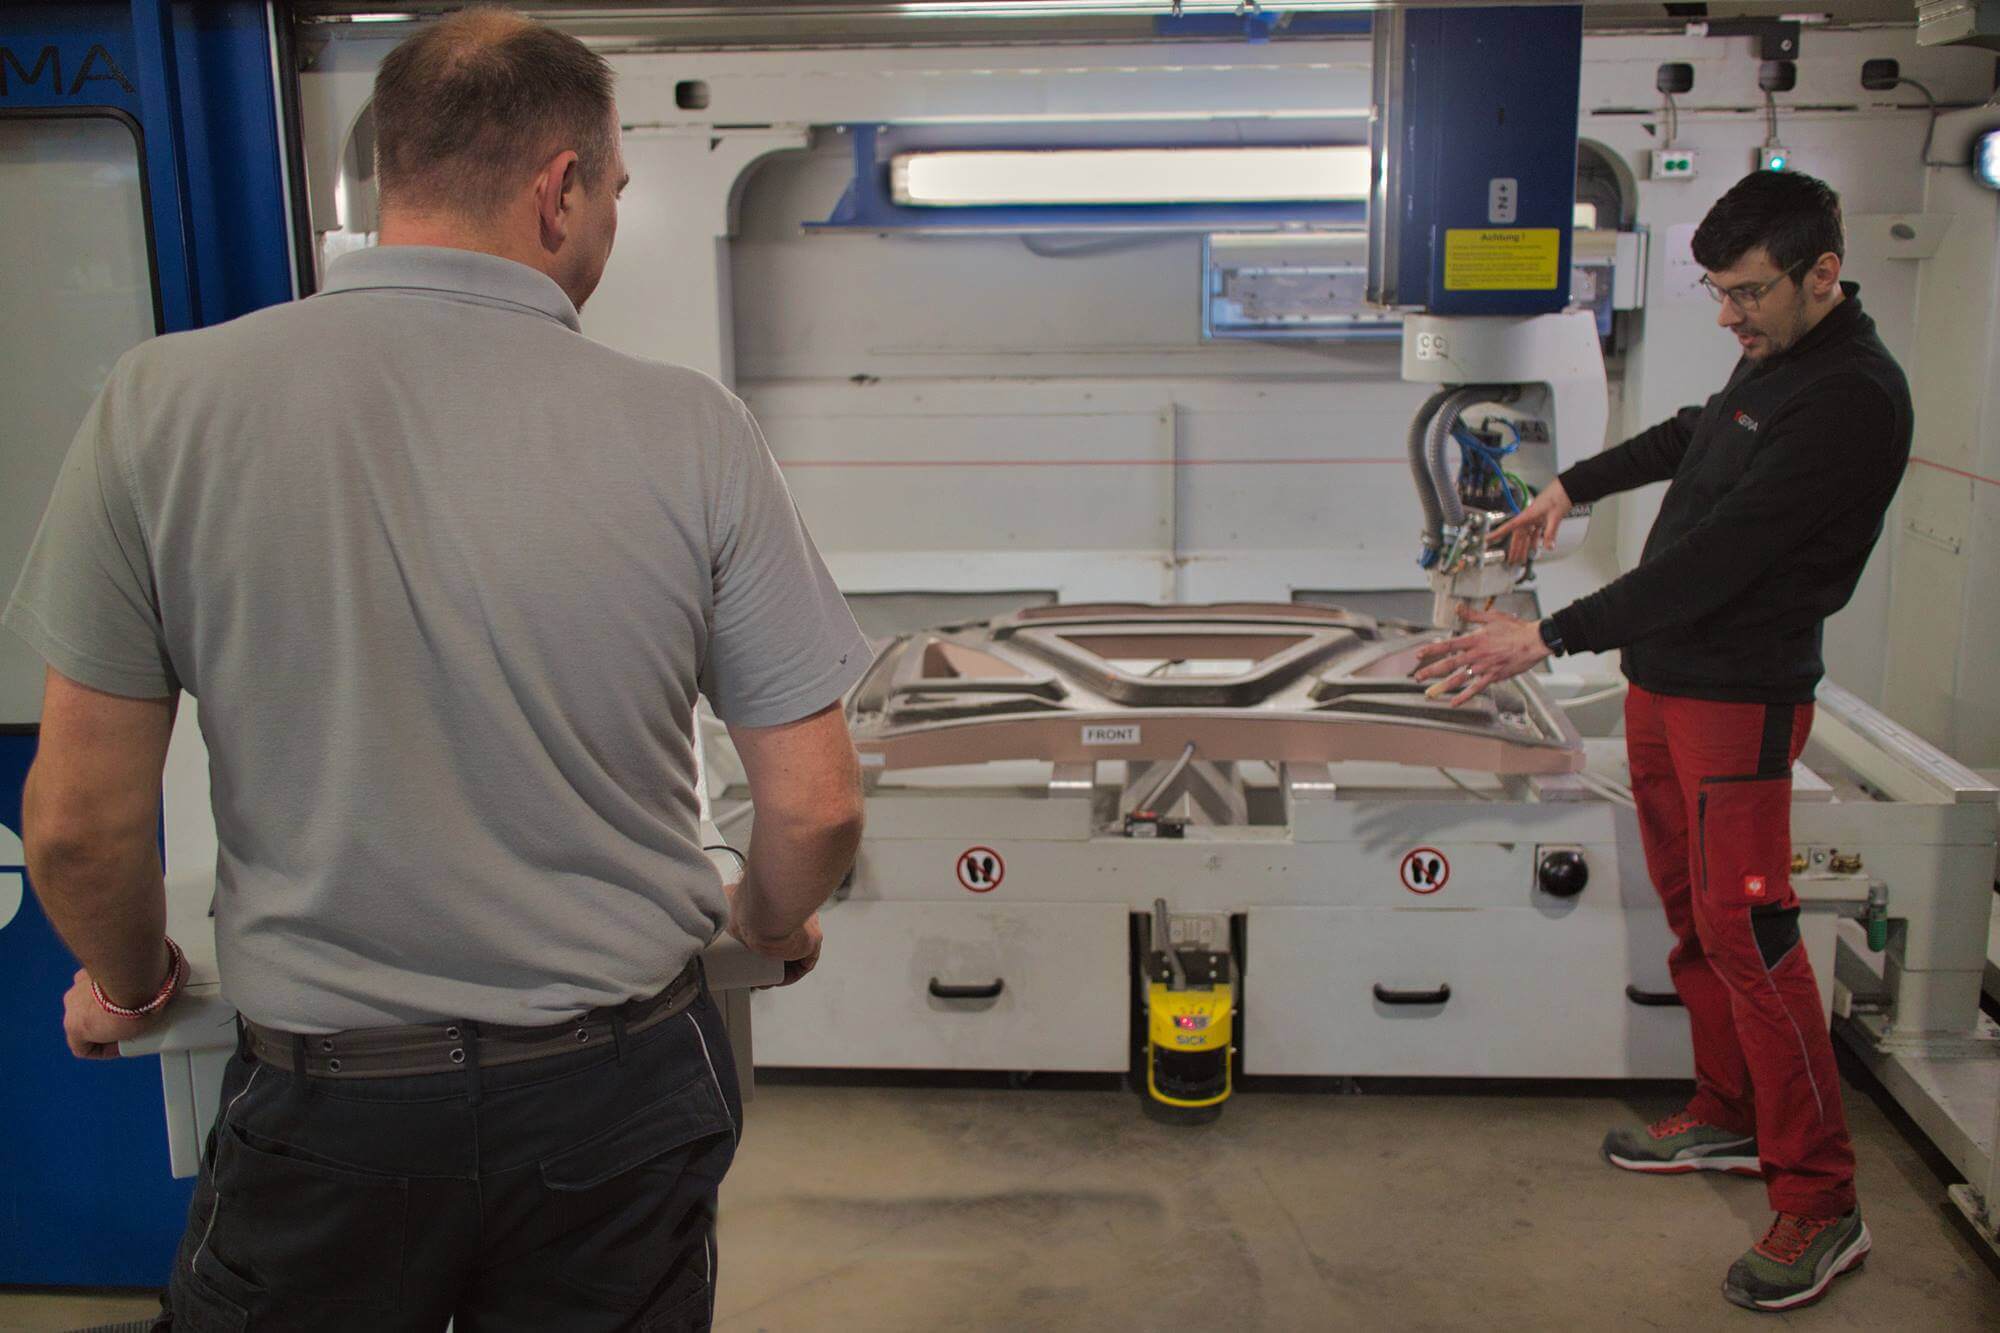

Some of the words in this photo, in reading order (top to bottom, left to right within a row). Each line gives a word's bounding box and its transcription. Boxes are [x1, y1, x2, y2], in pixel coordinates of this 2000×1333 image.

[1481, 232, 1519, 242] Achtung
[1087, 728, 1134, 740] FRONT
[1175, 1034, 1208, 1046] SICK
